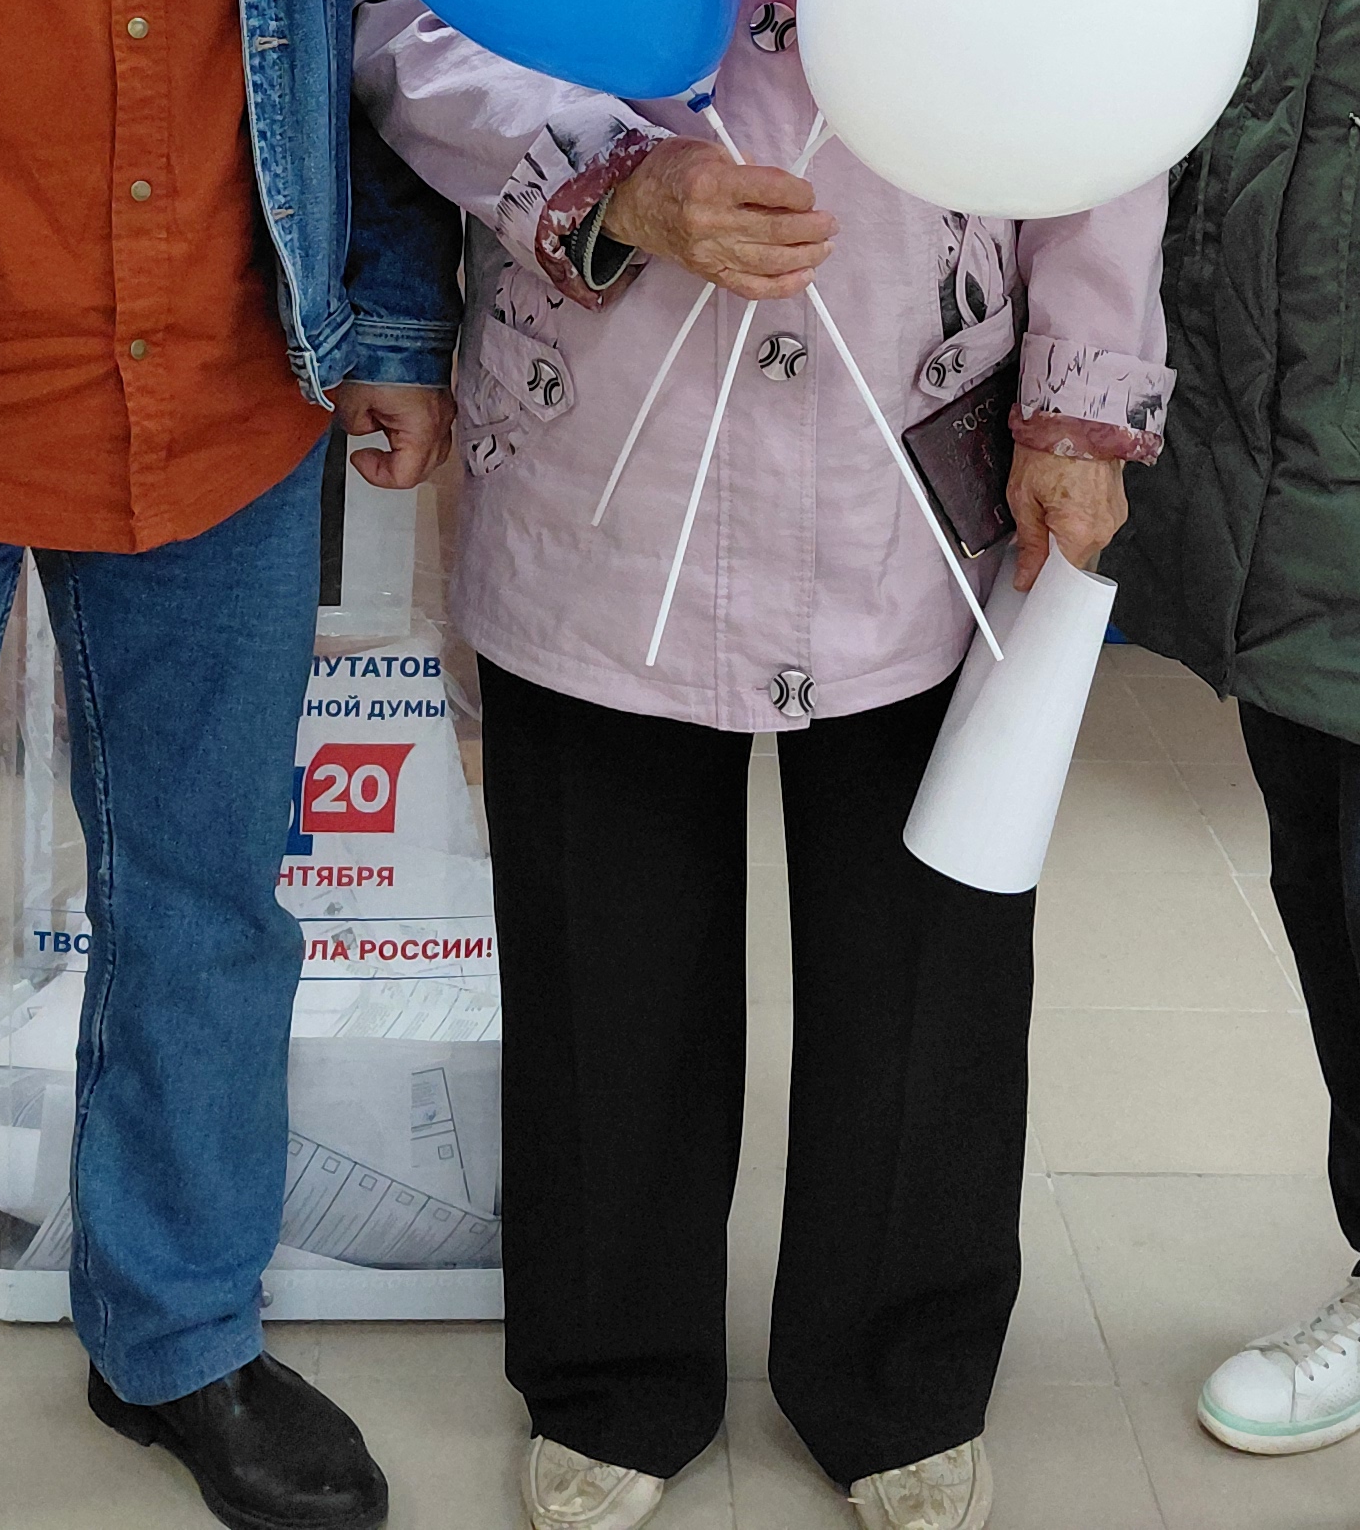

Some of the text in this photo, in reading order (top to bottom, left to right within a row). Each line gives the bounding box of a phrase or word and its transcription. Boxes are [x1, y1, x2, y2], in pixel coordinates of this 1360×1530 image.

[312, 656, 442, 678] УТАТОВ
[367, 699, 446, 721] ДУМЫ
[311, 764, 390, 813] 20
[276, 866, 395, 887] НТЯБРЯ
[33, 930, 493, 960] ТВО ЛА РОССИИ!
